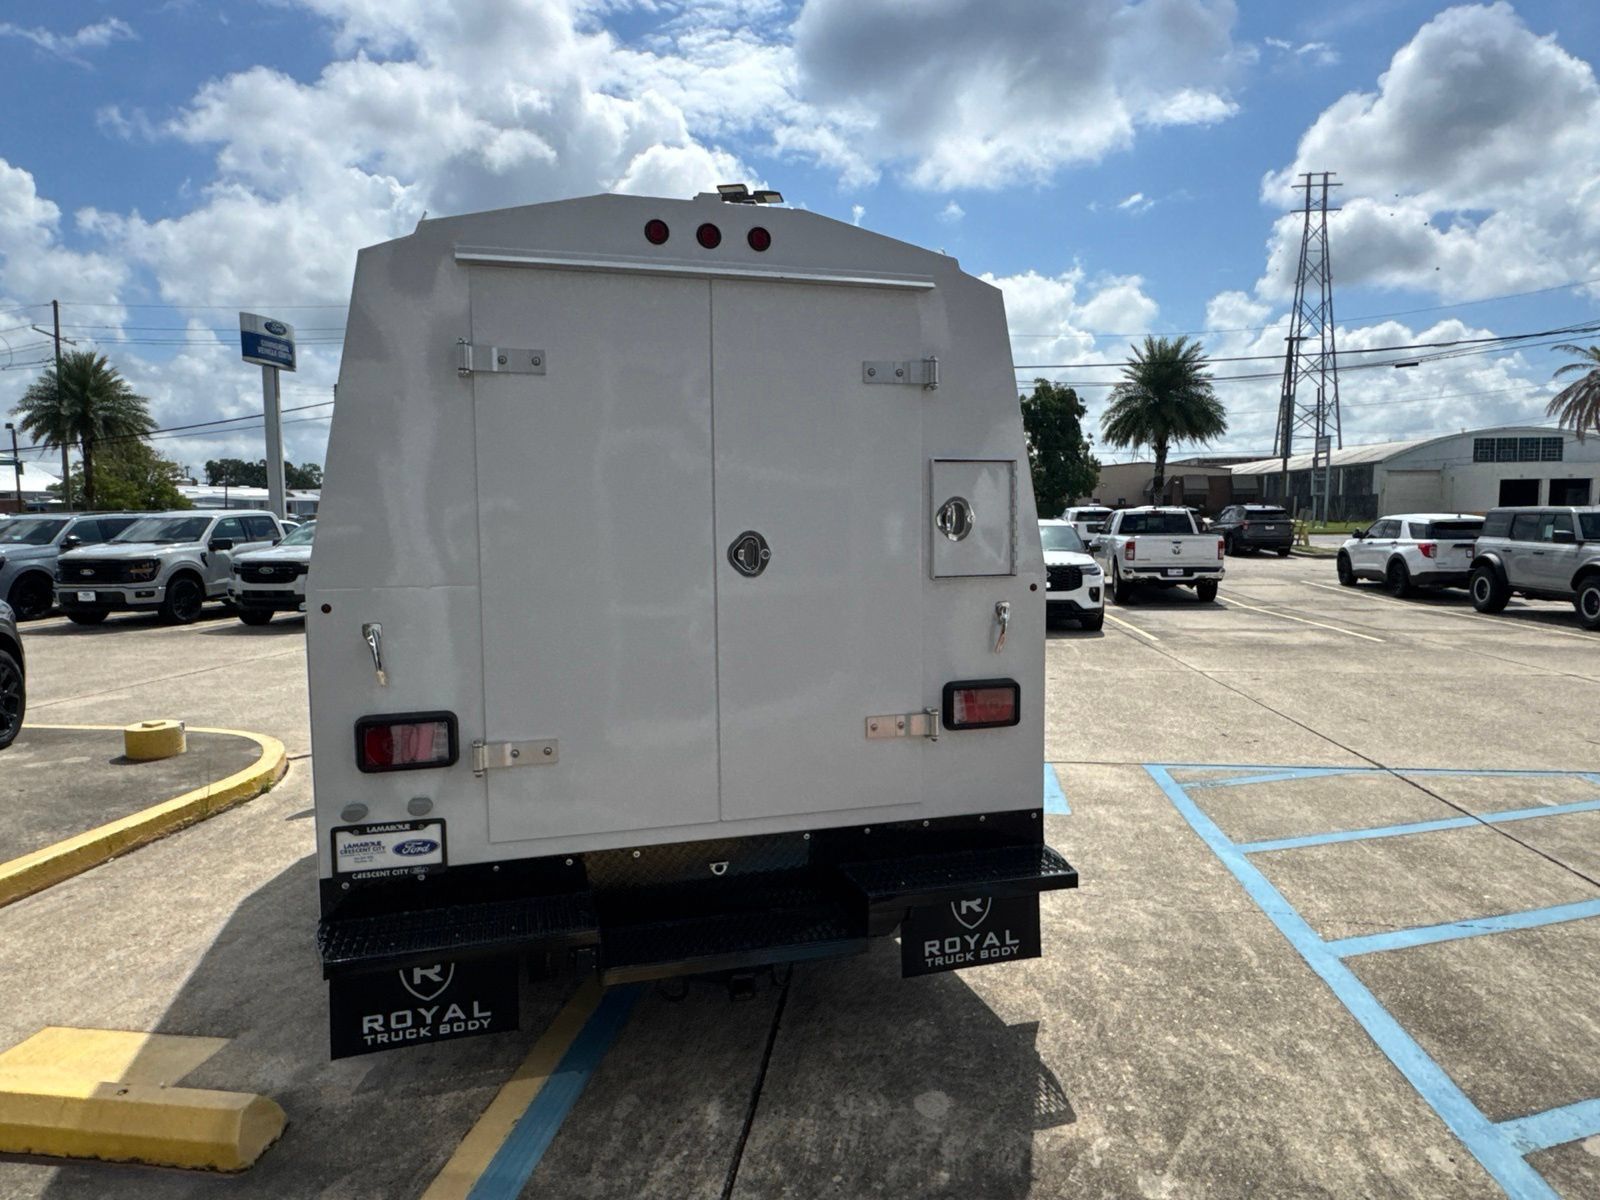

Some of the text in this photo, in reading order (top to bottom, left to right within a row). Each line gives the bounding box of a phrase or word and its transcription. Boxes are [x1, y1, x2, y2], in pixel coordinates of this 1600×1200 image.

[401, 841, 431, 854] Ford
[352, 869, 390, 880] CRESCENT
[392, 868, 409, 876] CITY
[960, 898, 983, 914] R
[924, 929, 1020, 957] ROYAL
[925, 945, 1020, 967] TRUCK BODY
[362, 1000, 492, 1034] ROYAL
[363, 1018, 492, 1046] TRUCK BODY
